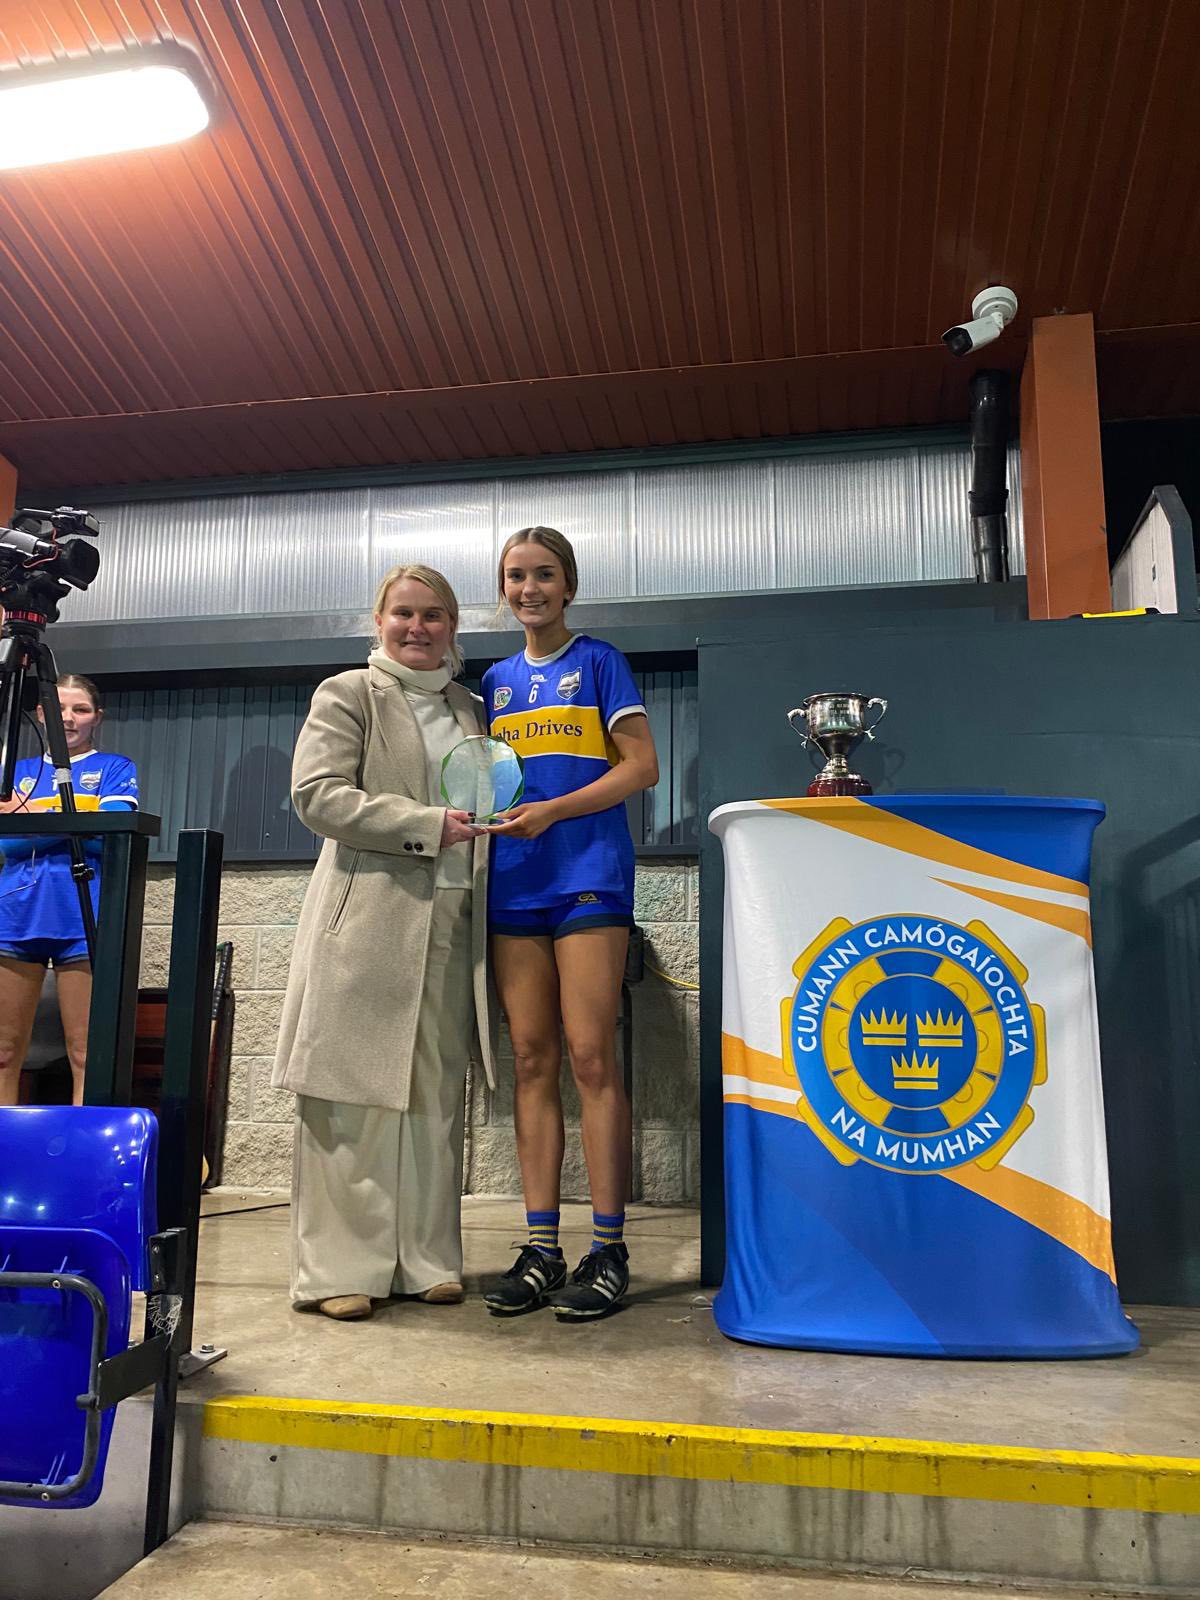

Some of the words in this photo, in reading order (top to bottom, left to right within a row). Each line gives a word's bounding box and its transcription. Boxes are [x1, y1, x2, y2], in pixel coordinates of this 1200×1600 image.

[528, 683, 540, 704] 6
[526, 719, 583, 739] Drives
[797, 938, 861, 1053] CUMANN
[864, 922, 1028, 1057] CAMÓGAÍOCHTA
[830, 1106, 866, 1148] NA
[876, 1111, 1002, 1164] MUMHAN
